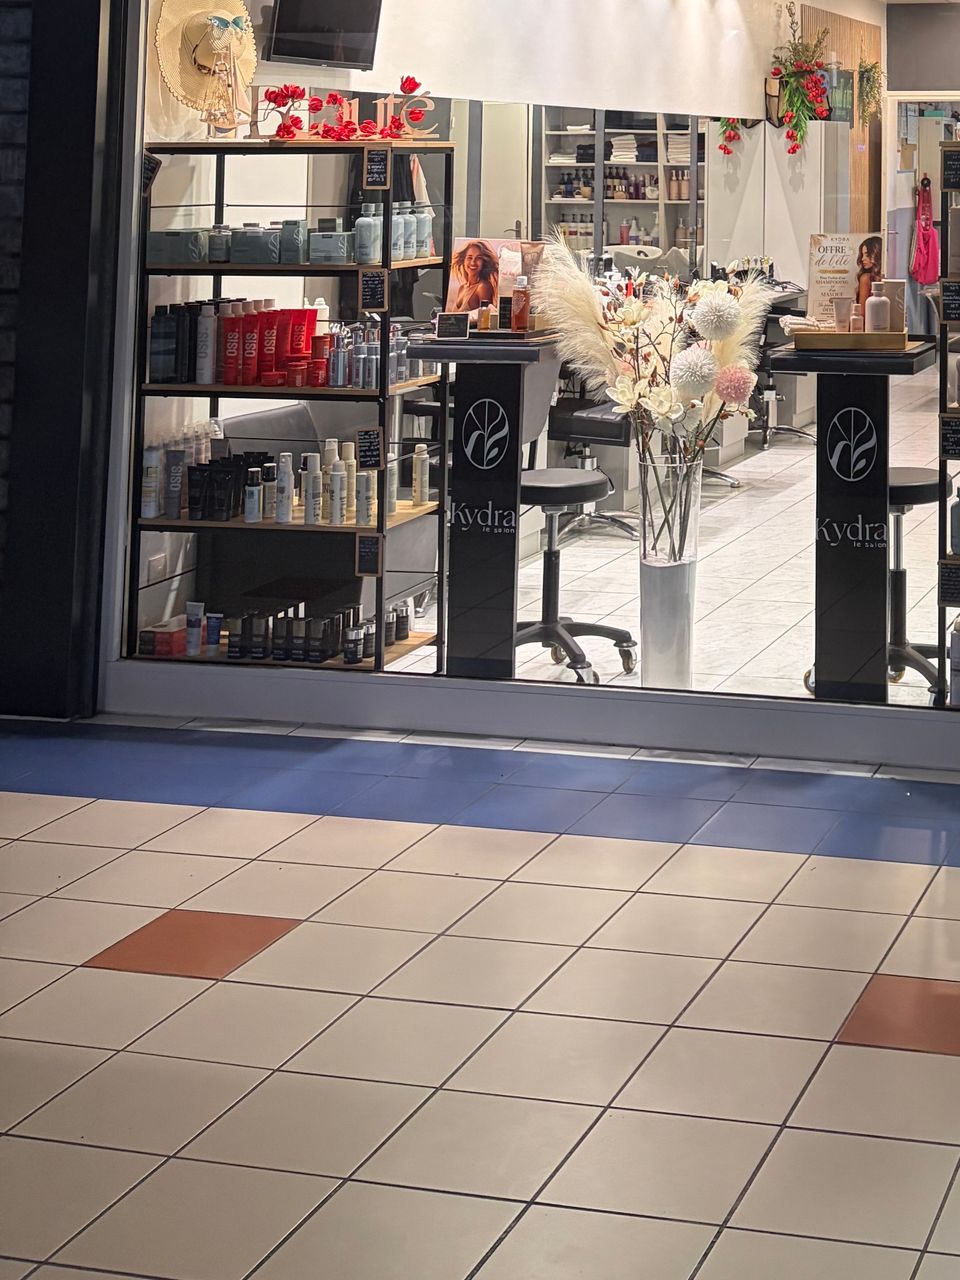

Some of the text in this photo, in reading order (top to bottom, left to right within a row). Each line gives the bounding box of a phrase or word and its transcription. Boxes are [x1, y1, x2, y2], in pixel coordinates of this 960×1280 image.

[817, 245, 847, 255] OFFRE
[450, 500, 516, 531] Kydra
[815, 513, 888, 547] Kydra
